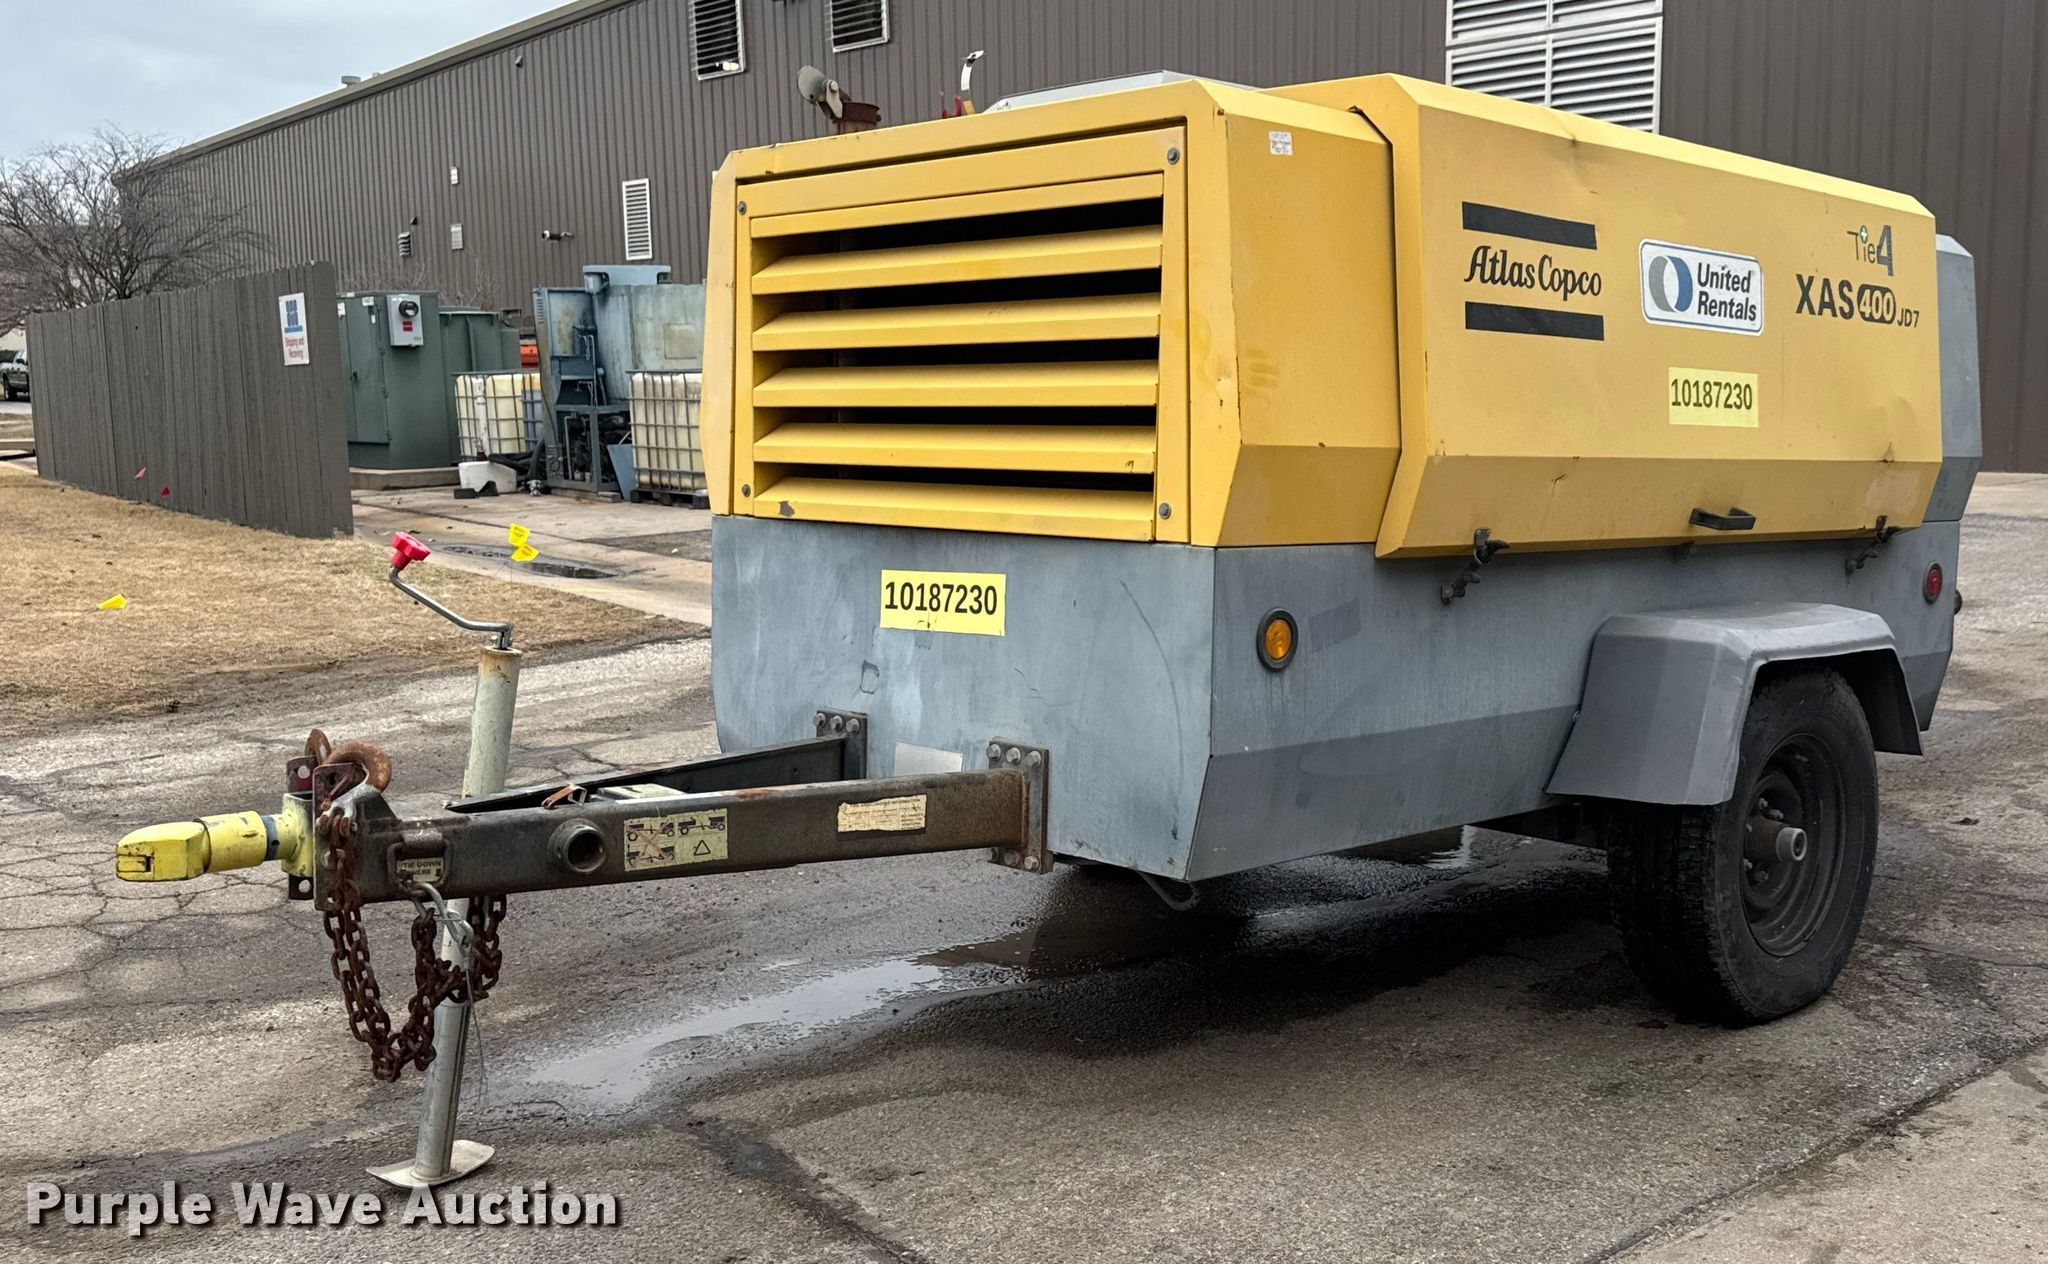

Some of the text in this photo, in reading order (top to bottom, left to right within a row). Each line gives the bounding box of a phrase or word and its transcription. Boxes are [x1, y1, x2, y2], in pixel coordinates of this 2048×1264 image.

[1464, 245, 1602, 301] Atlas Copco
[1697, 262, 1752, 293] United
[1697, 290, 1757, 321] Rentals
[1795, 273, 1920, 328] XAS 400 JD7
[1671, 378, 1752, 410] 10187230
[885, 581, 998, 615] 10187230
[416, 860, 442, 868] DOWN
